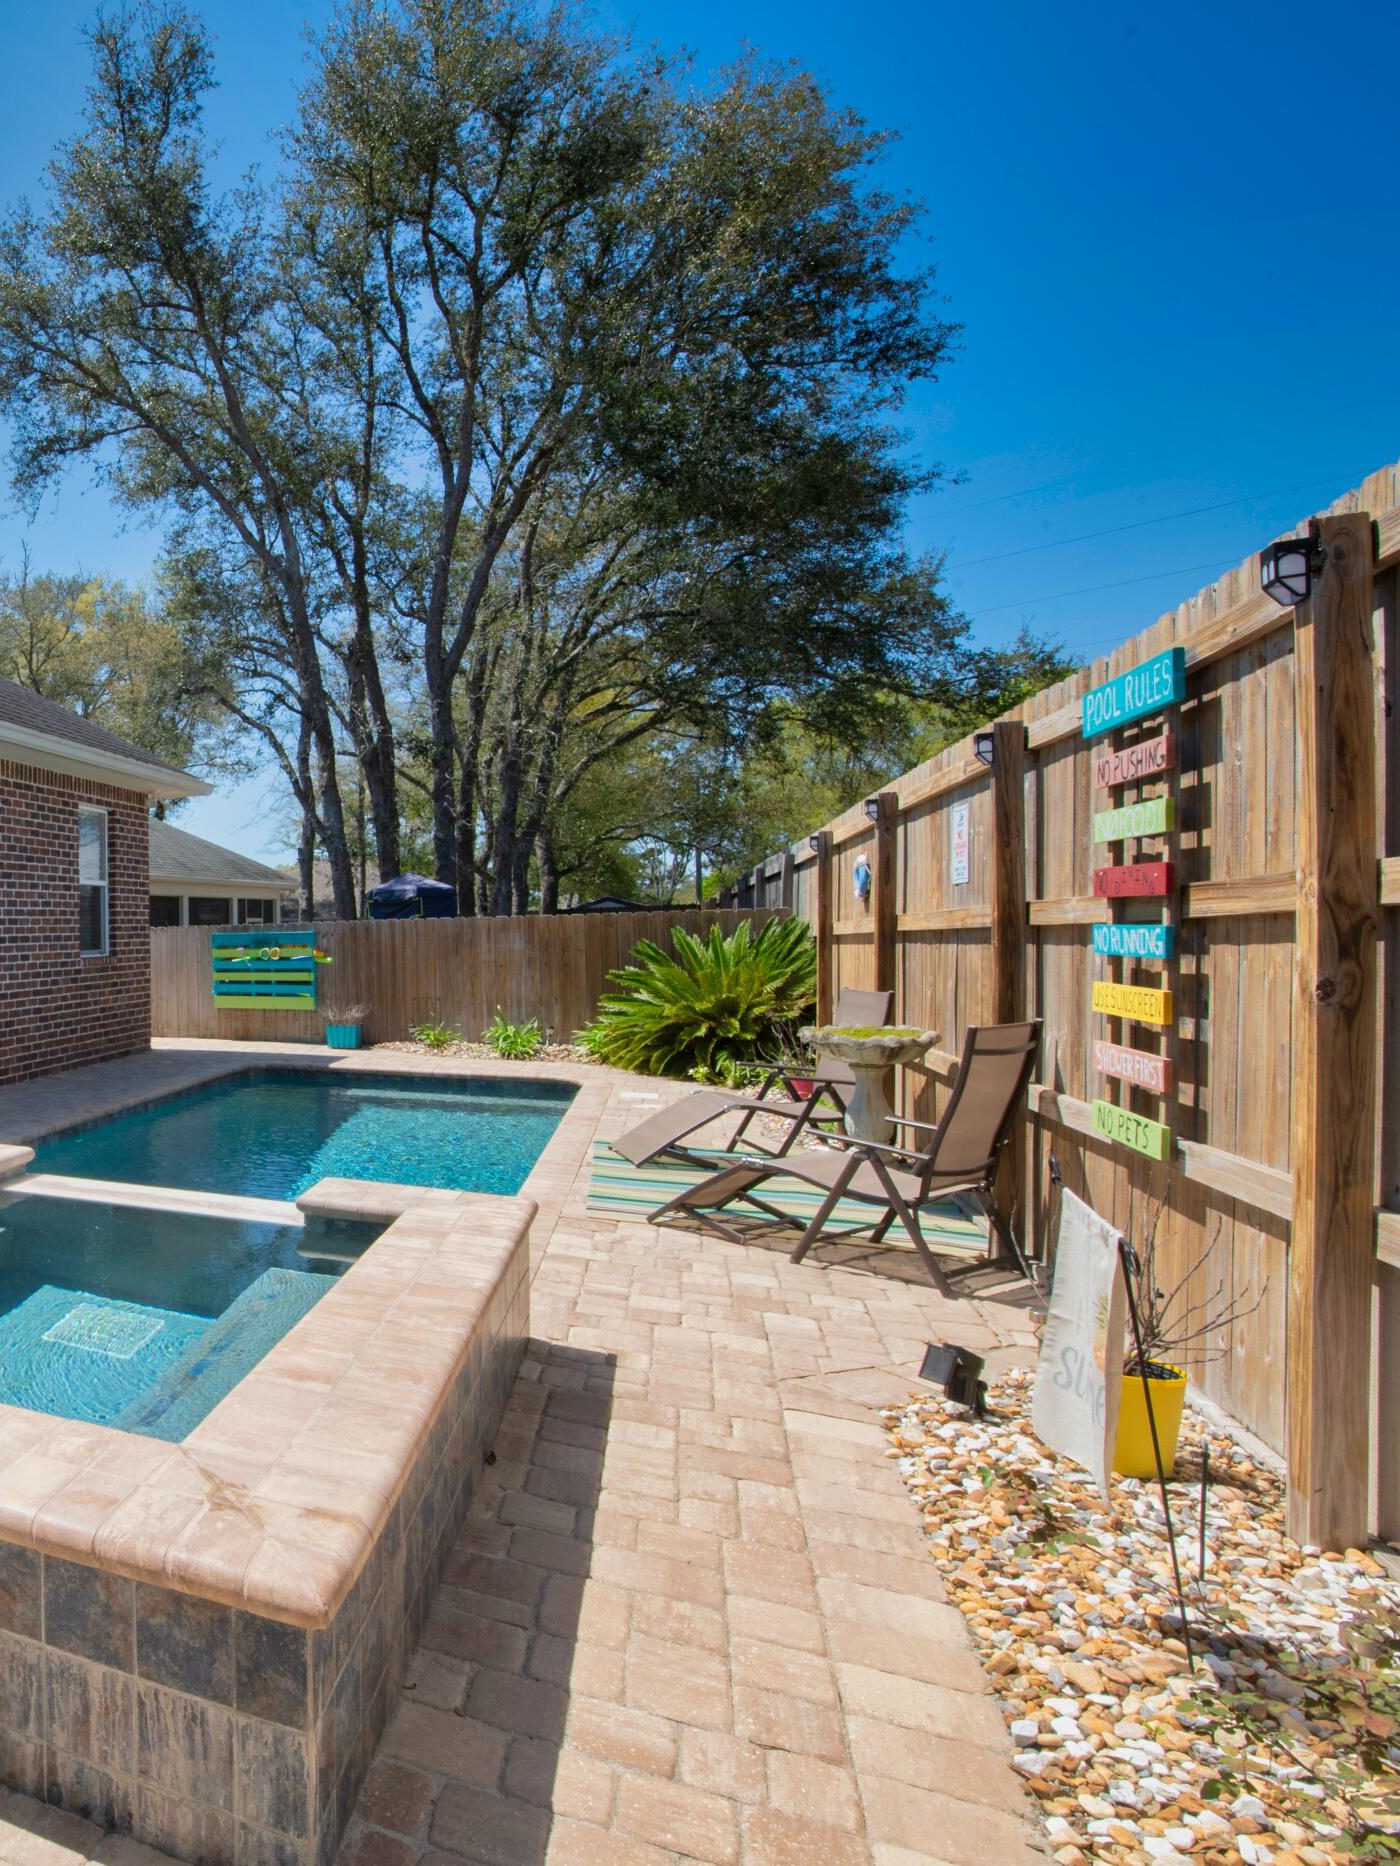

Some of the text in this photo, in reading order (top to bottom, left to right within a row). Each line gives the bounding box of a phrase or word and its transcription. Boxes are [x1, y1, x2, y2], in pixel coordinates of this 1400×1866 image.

[1086, 659, 1173, 732] POOL RULES
[1097, 741, 1166, 785] NO PUSHING
[1094, 926, 1164, 956] NO RUNNING
[1094, 984, 1162, 1018] USE SUNSCREEN
[1095, 1043, 1164, 1093] SHOWER FIRST
[1097, 1106, 1149, 1149] NO PETS
